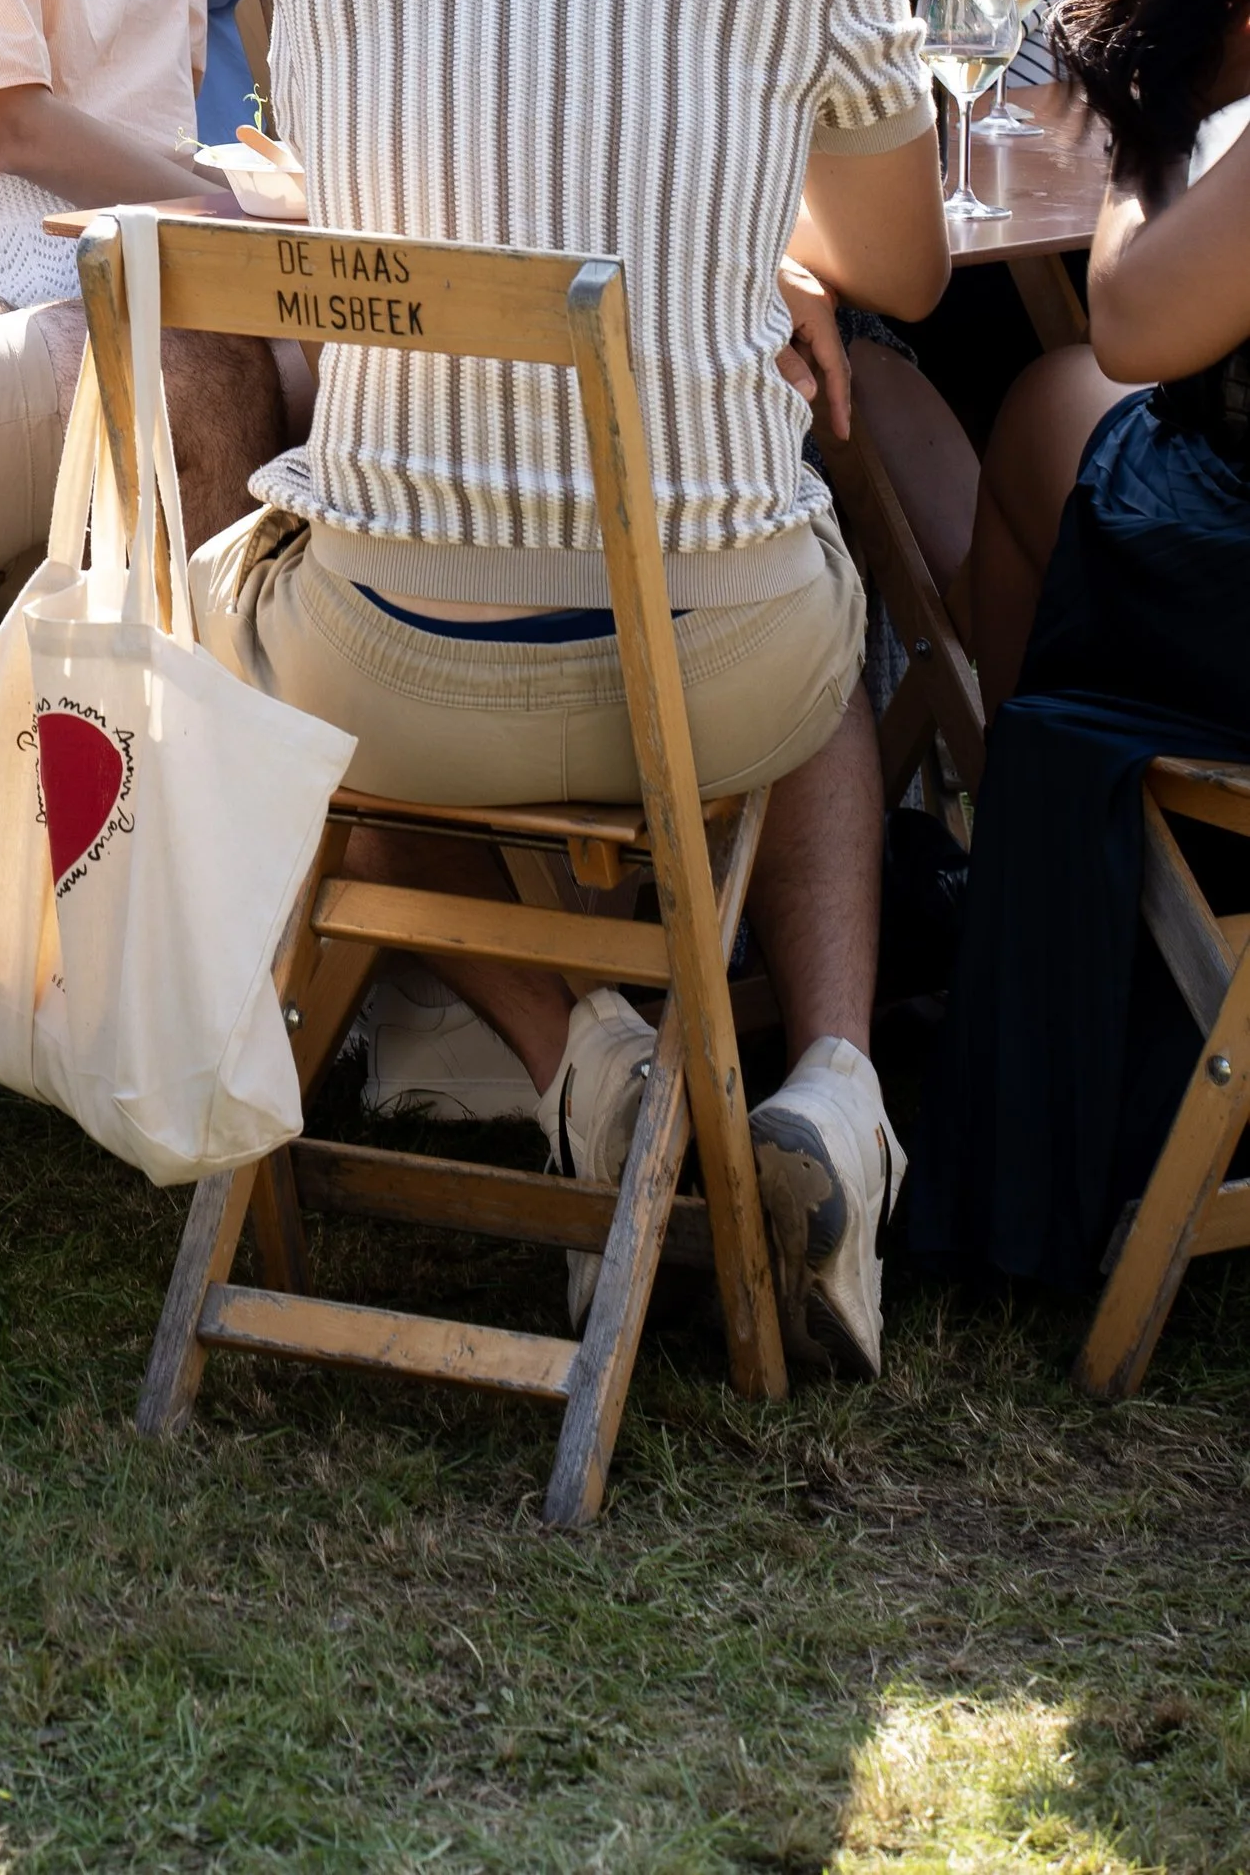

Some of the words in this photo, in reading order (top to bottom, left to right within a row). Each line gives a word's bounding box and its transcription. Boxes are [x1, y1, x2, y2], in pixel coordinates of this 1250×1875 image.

[277, 239, 313, 276] DE
[330, 244, 410, 284] HAAS
[277, 290, 424, 336] MILSBEEK
[58, 696, 107, 729] mon
[87, 805, 135, 863] Paris
